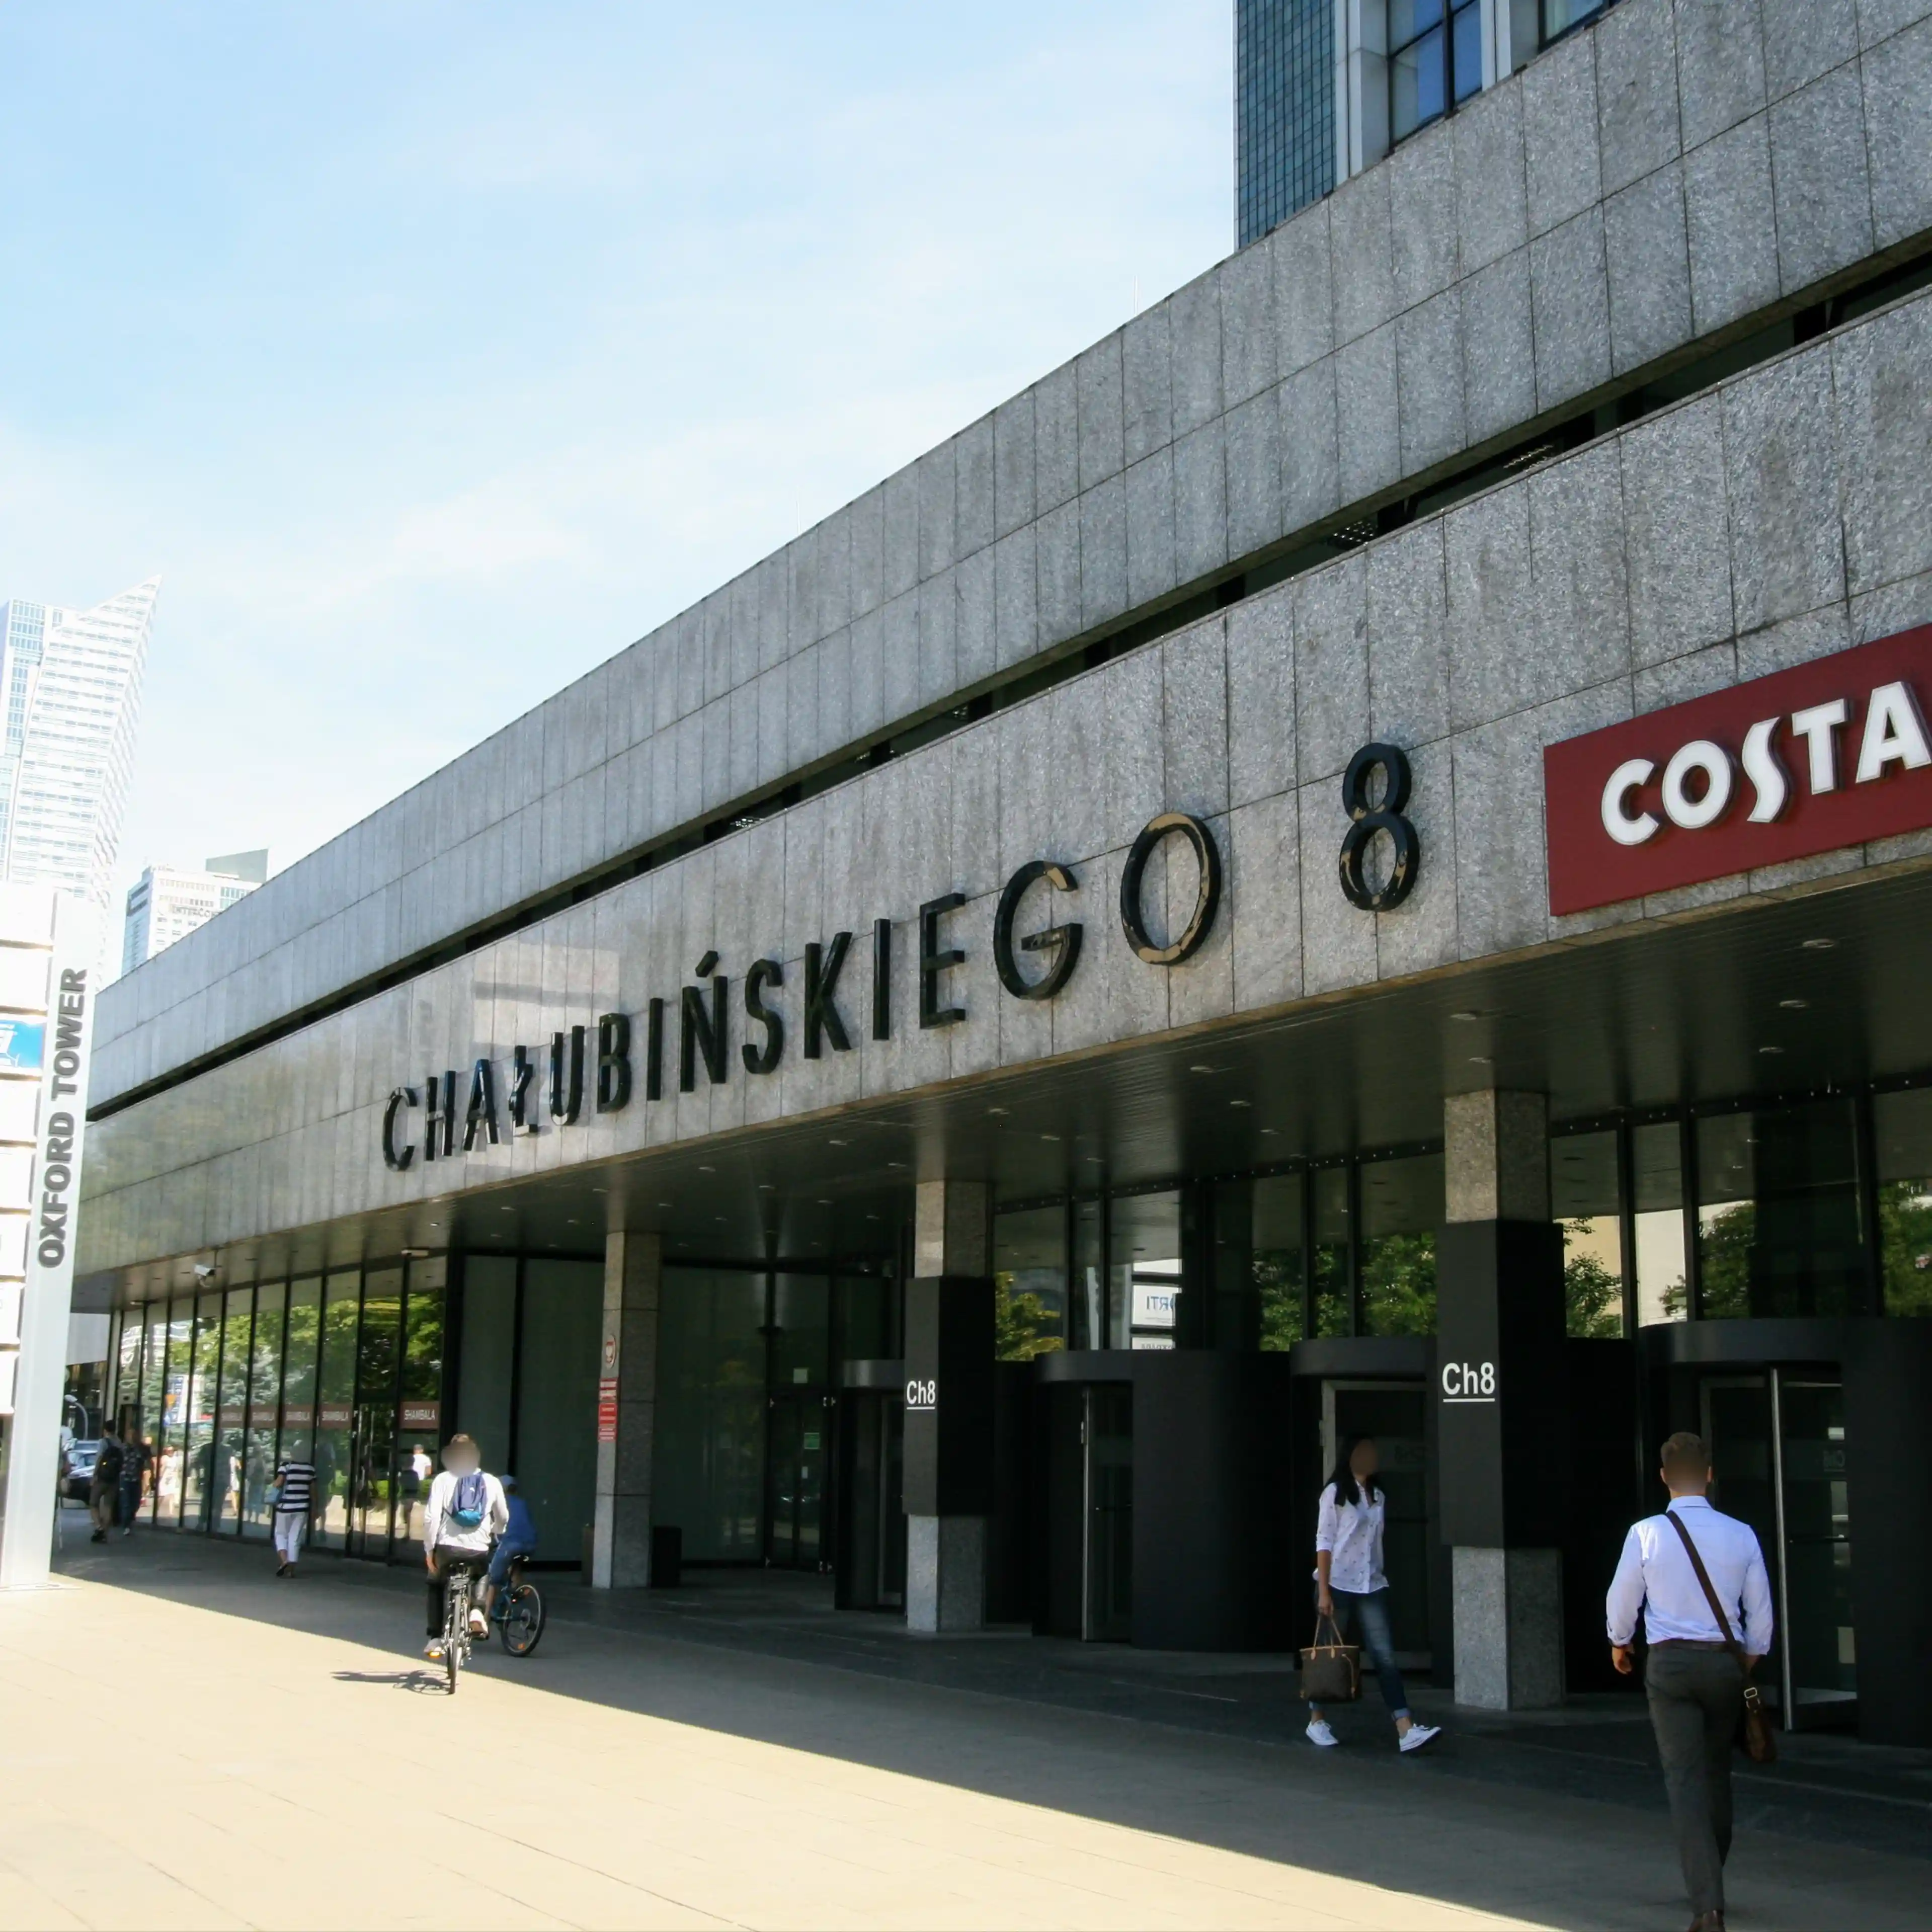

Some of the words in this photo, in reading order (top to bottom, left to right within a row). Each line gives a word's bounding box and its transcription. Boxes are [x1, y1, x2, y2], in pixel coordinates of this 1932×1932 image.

[1601, 681, 1931, 846] COSTA
[382, 812, 1222, 1171] CHAŁUBIŃSKIEGO
[1339, 743, 1420, 912] 8
[51, 967, 88, 1102] TOWER
[37, 1111, 76, 1268] OXFORD
[404, 1409, 436, 1420] SHAMBALA
[906, 1380, 936, 1405] Ch8
[1442, 1362, 1496, 1395] Ch8
